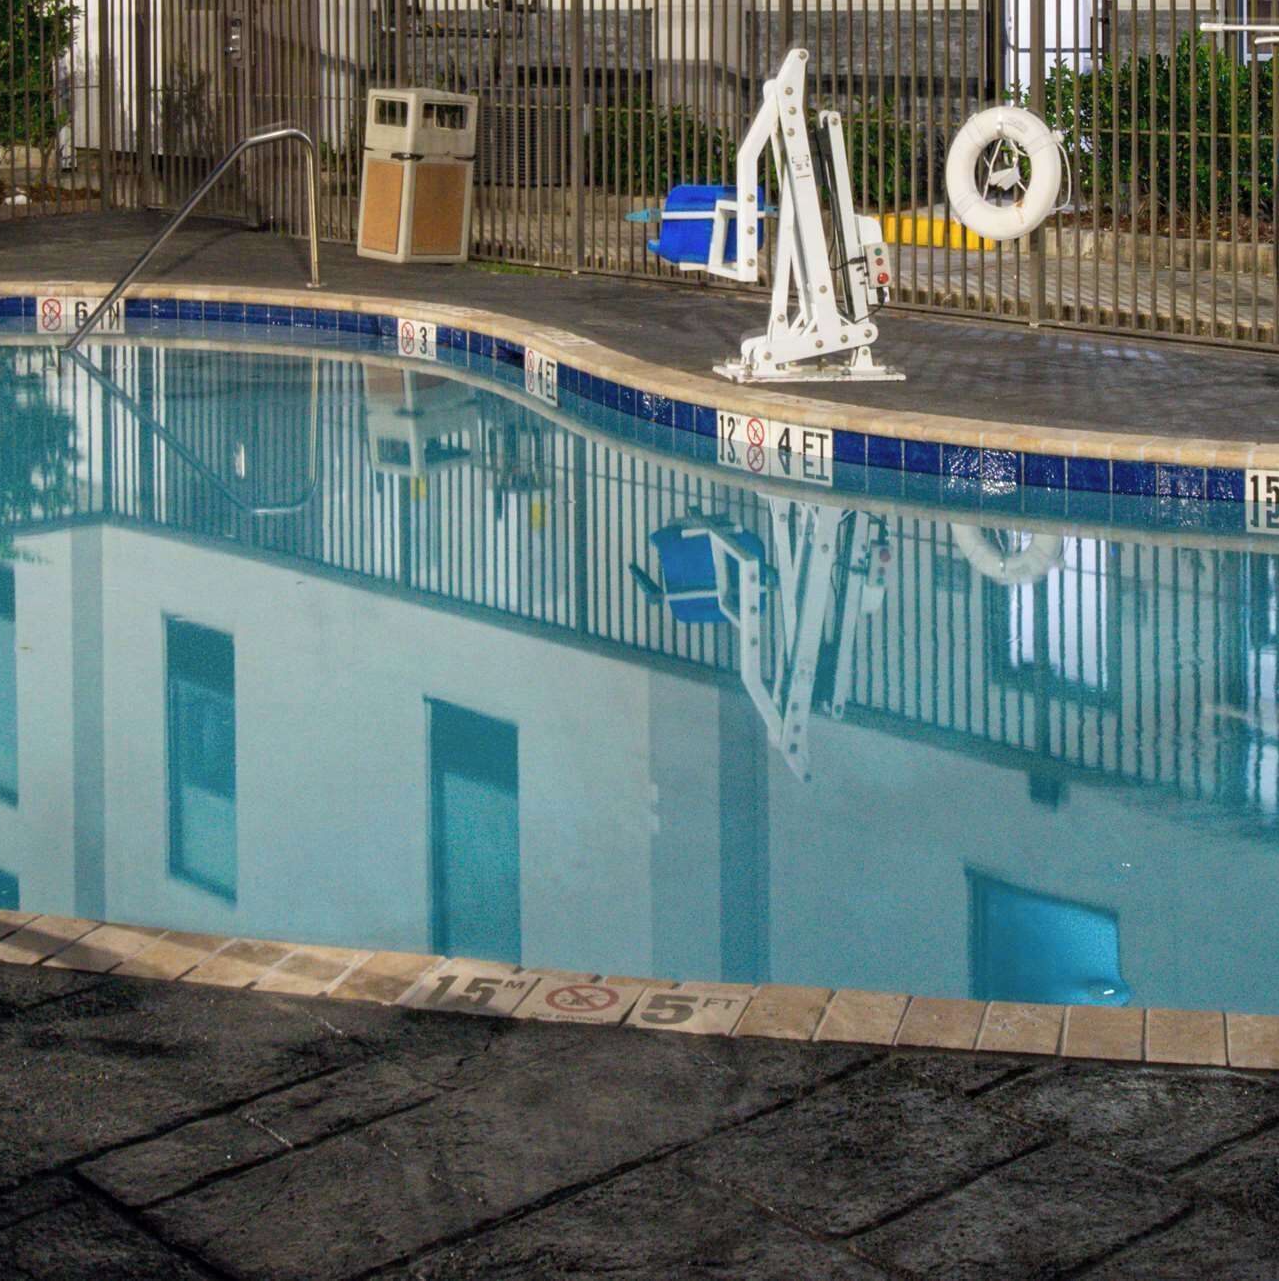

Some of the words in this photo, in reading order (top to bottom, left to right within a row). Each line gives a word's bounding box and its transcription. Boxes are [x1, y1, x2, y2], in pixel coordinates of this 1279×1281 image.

[420, 326, 427, 343] 3
[778, 427, 791, 453] 4
[803, 430, 829, 458] FT
[425, 975, 503, 1007] 15
[504, 980, 526, 989] M
[640, 993, 698, 1025] 5
[702, 996, 741, 1010] FT
